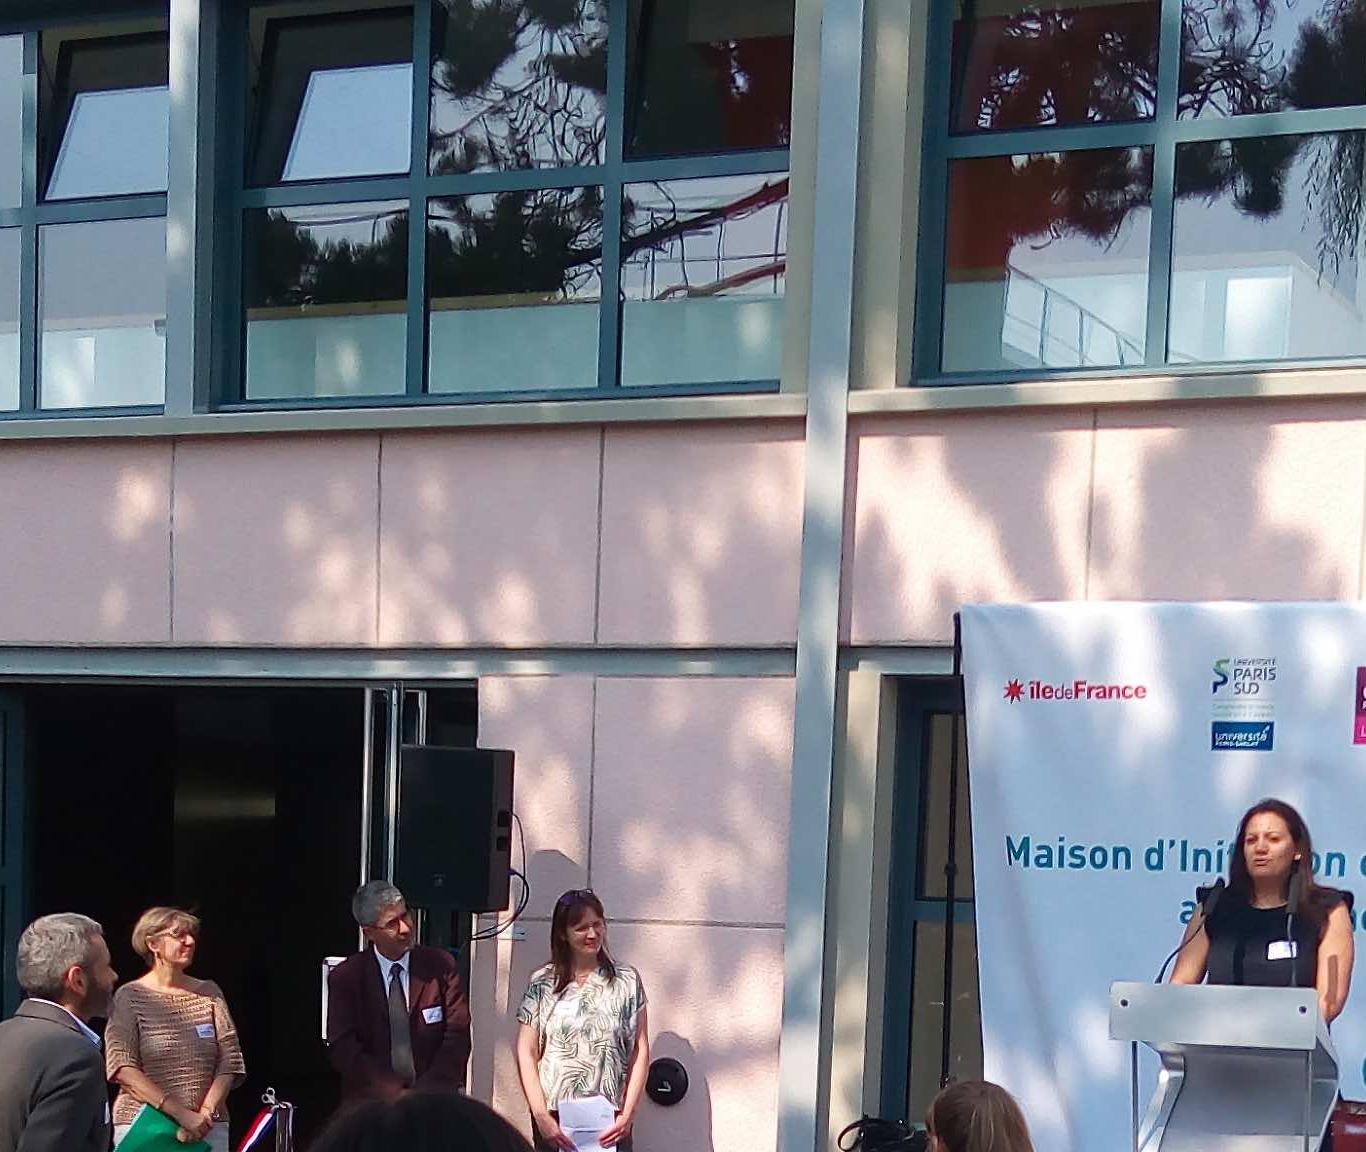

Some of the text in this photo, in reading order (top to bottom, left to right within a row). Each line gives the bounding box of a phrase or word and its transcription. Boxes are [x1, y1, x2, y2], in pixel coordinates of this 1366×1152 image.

[1233, 667, 1277, 681] PARIS
[1234, 682, 1260, 695] SUD
[1005, 836, 1132, 870] Maison
